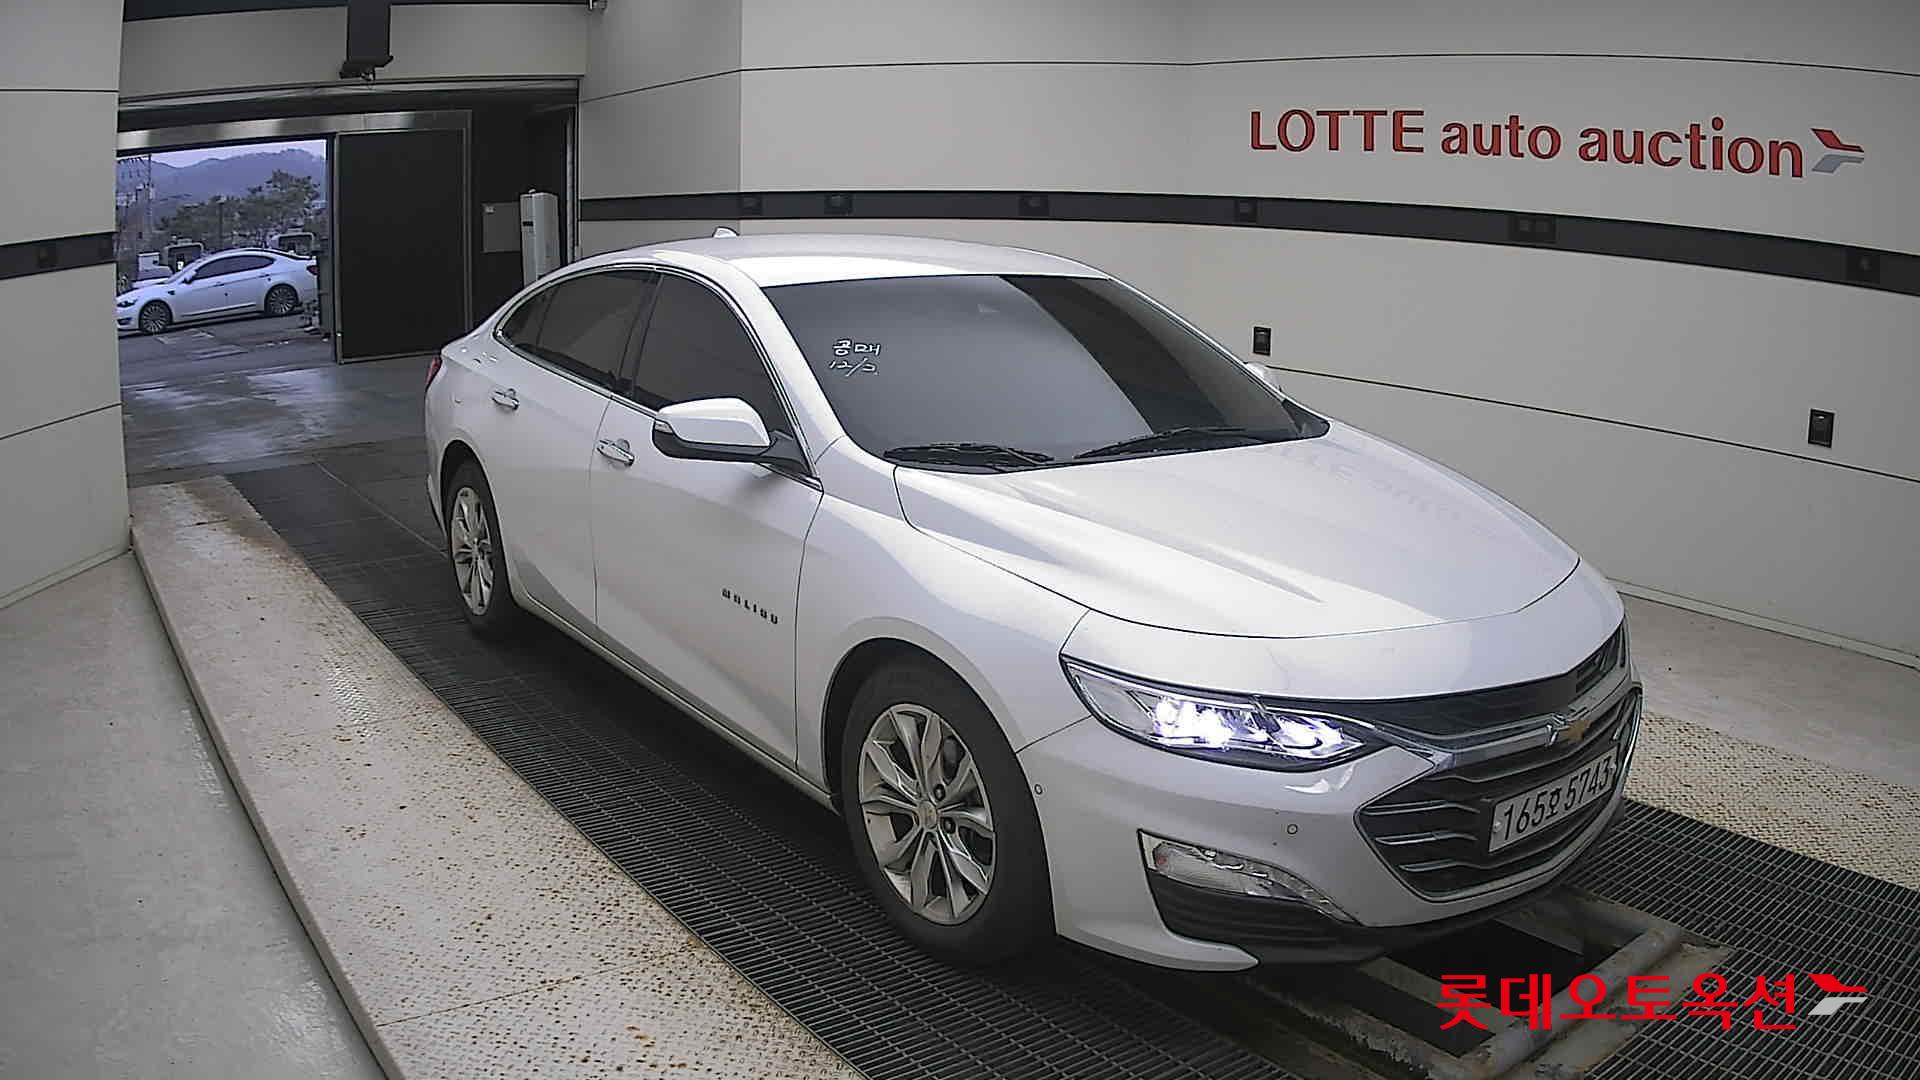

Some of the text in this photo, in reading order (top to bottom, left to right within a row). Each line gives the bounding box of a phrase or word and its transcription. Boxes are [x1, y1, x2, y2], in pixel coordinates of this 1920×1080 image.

[1250, 109, 1805, 178] LOTTE auto auction
[1564, 755, 1613, 812] 5743
